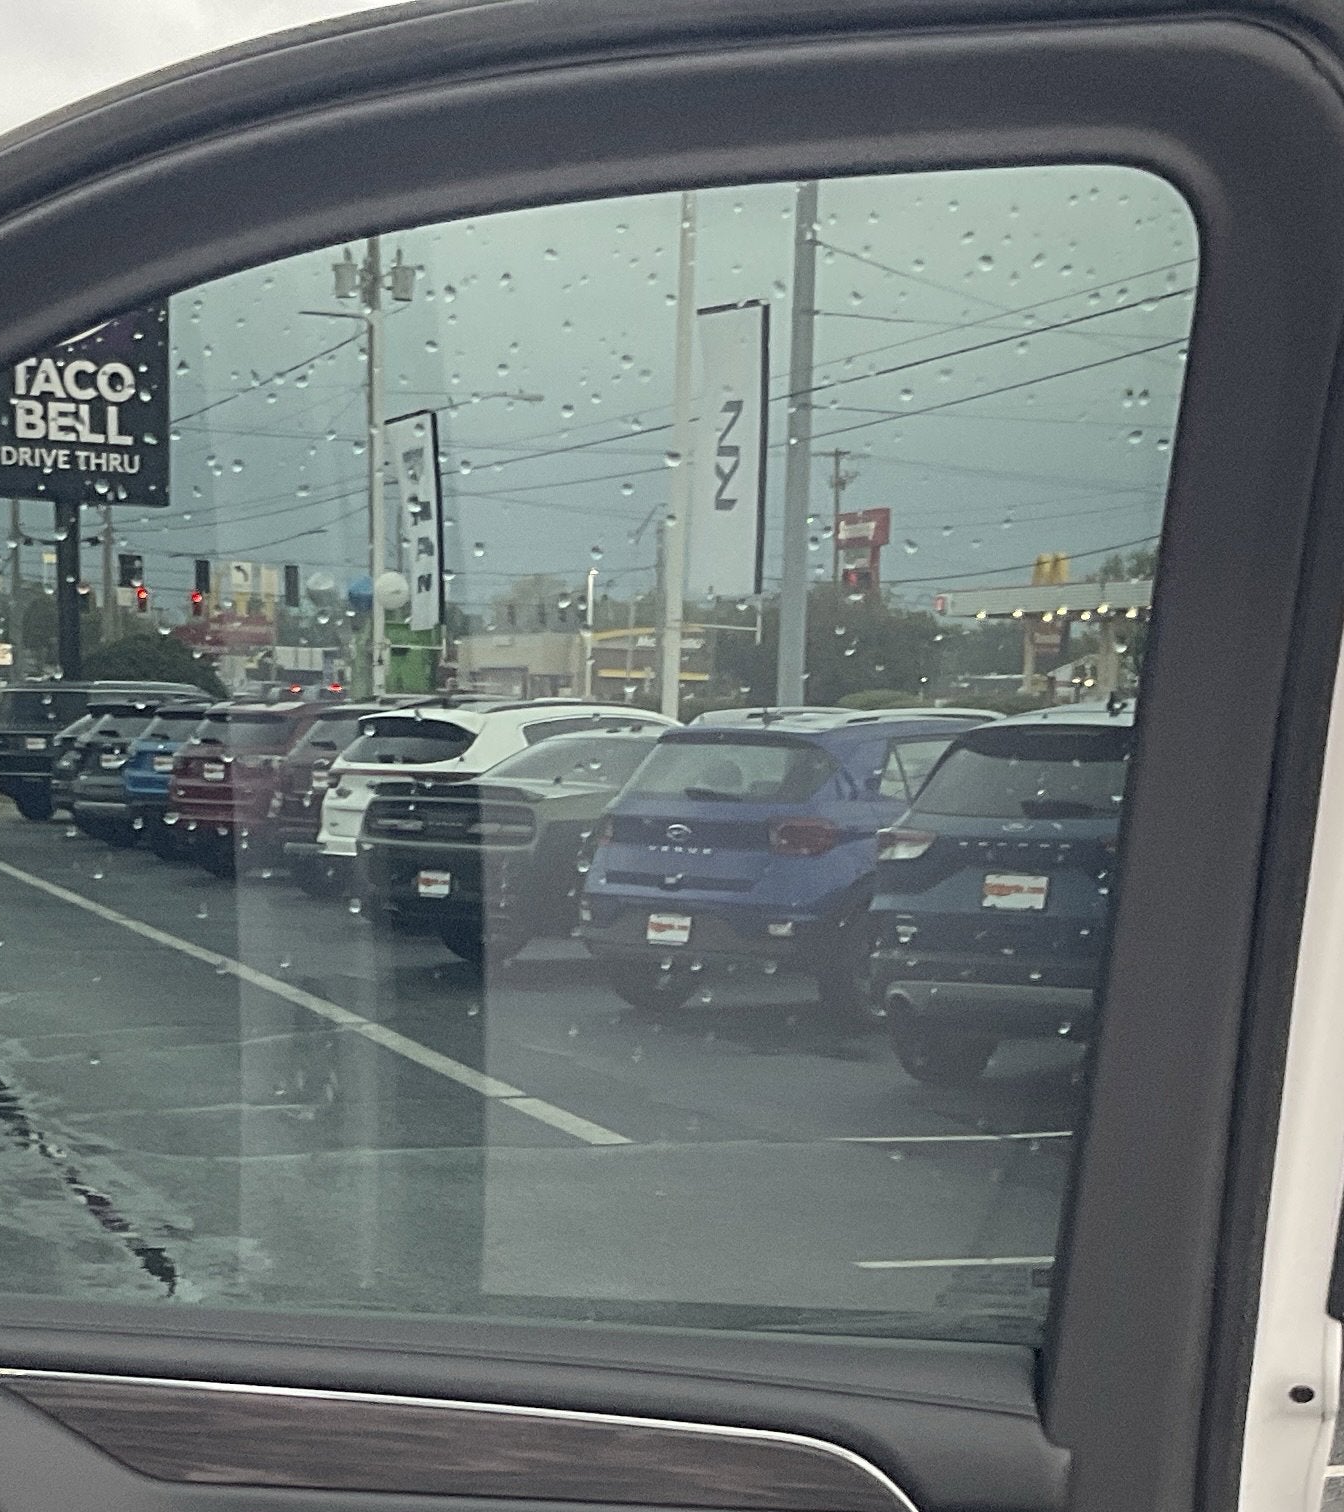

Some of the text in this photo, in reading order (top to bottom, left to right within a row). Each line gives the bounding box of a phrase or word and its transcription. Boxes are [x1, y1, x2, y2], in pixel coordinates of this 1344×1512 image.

[14, 357, 136, 402] TACO
[15, 400, 134, 446] BELL
[0, 446, 140, 474] DRIVE THRU
